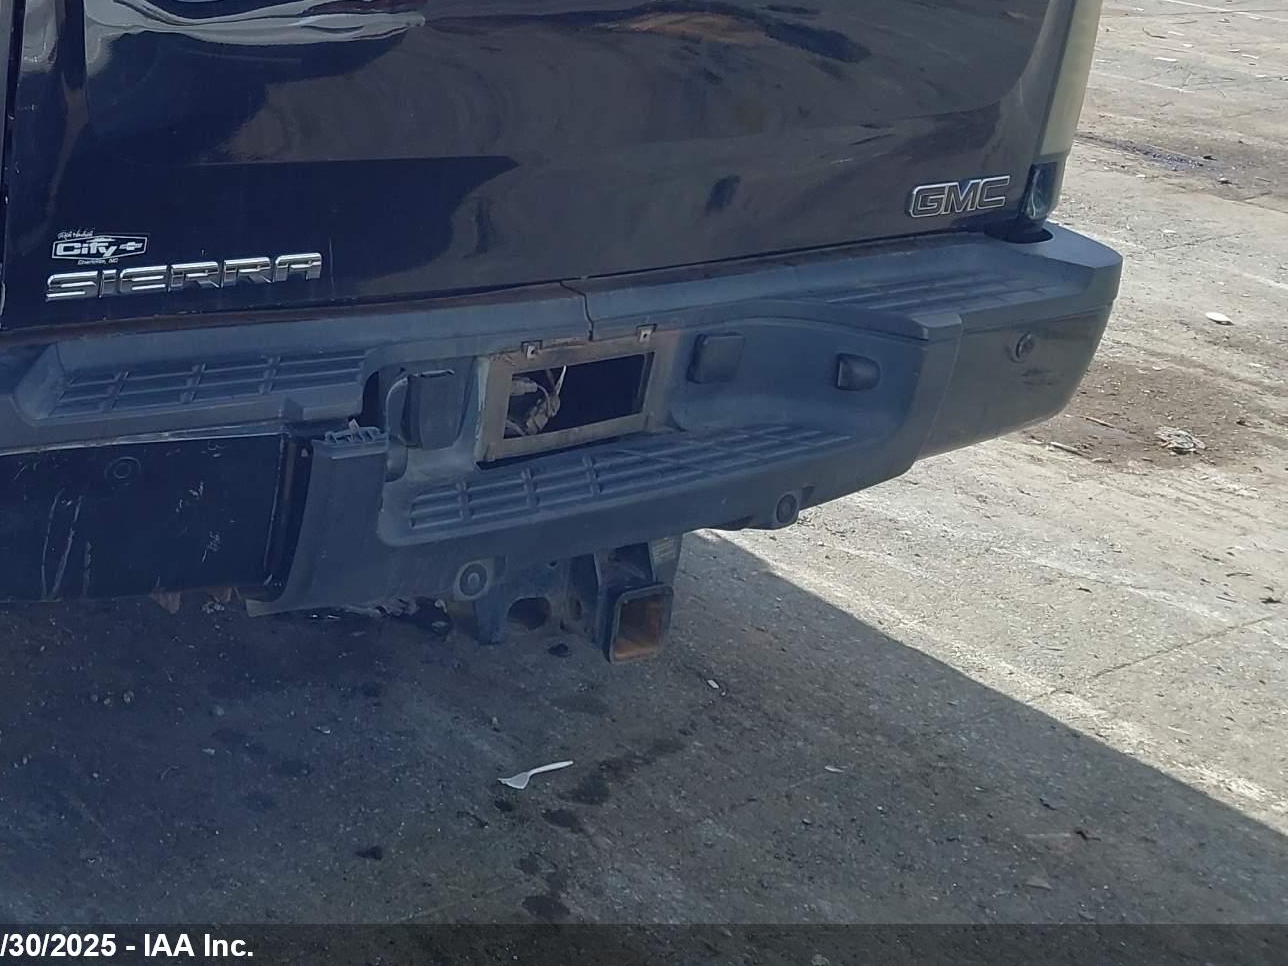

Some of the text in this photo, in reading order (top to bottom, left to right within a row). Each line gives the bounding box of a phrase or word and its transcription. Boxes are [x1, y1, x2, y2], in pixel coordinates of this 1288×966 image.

[908, 175, 1011, 218] GMC
[55, 242, 118, 258] City
[45, 252, 323, 300] SIERRA
